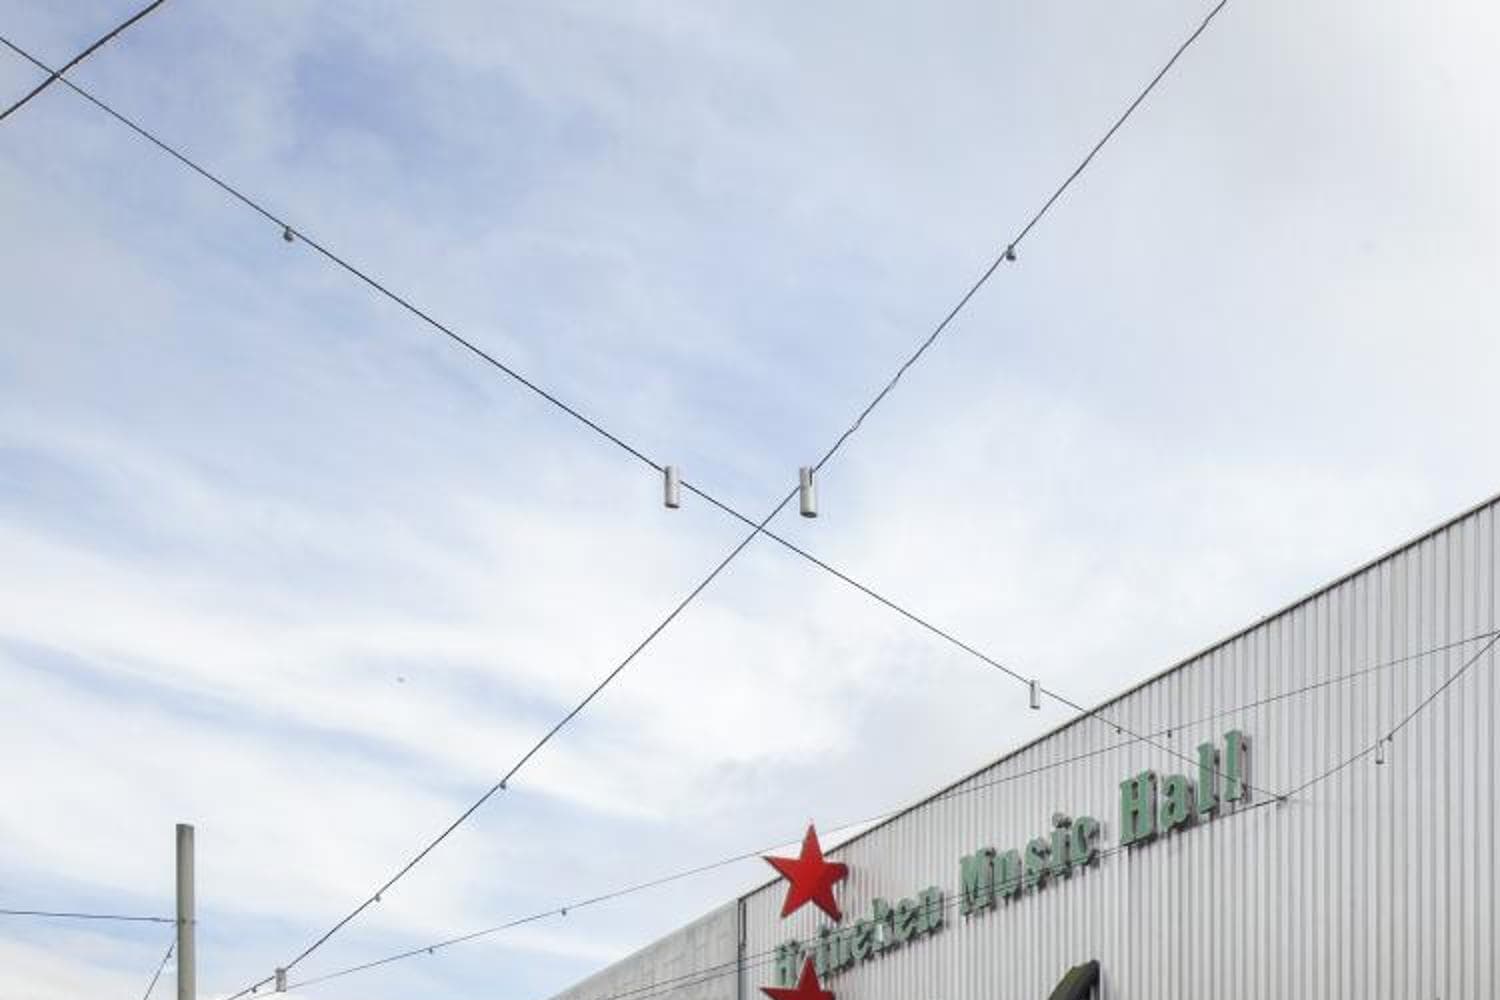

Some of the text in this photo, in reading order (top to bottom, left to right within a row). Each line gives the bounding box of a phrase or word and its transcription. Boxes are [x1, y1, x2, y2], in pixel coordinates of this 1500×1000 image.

[769, 729, 1247, 987] Hineken Music Hall
